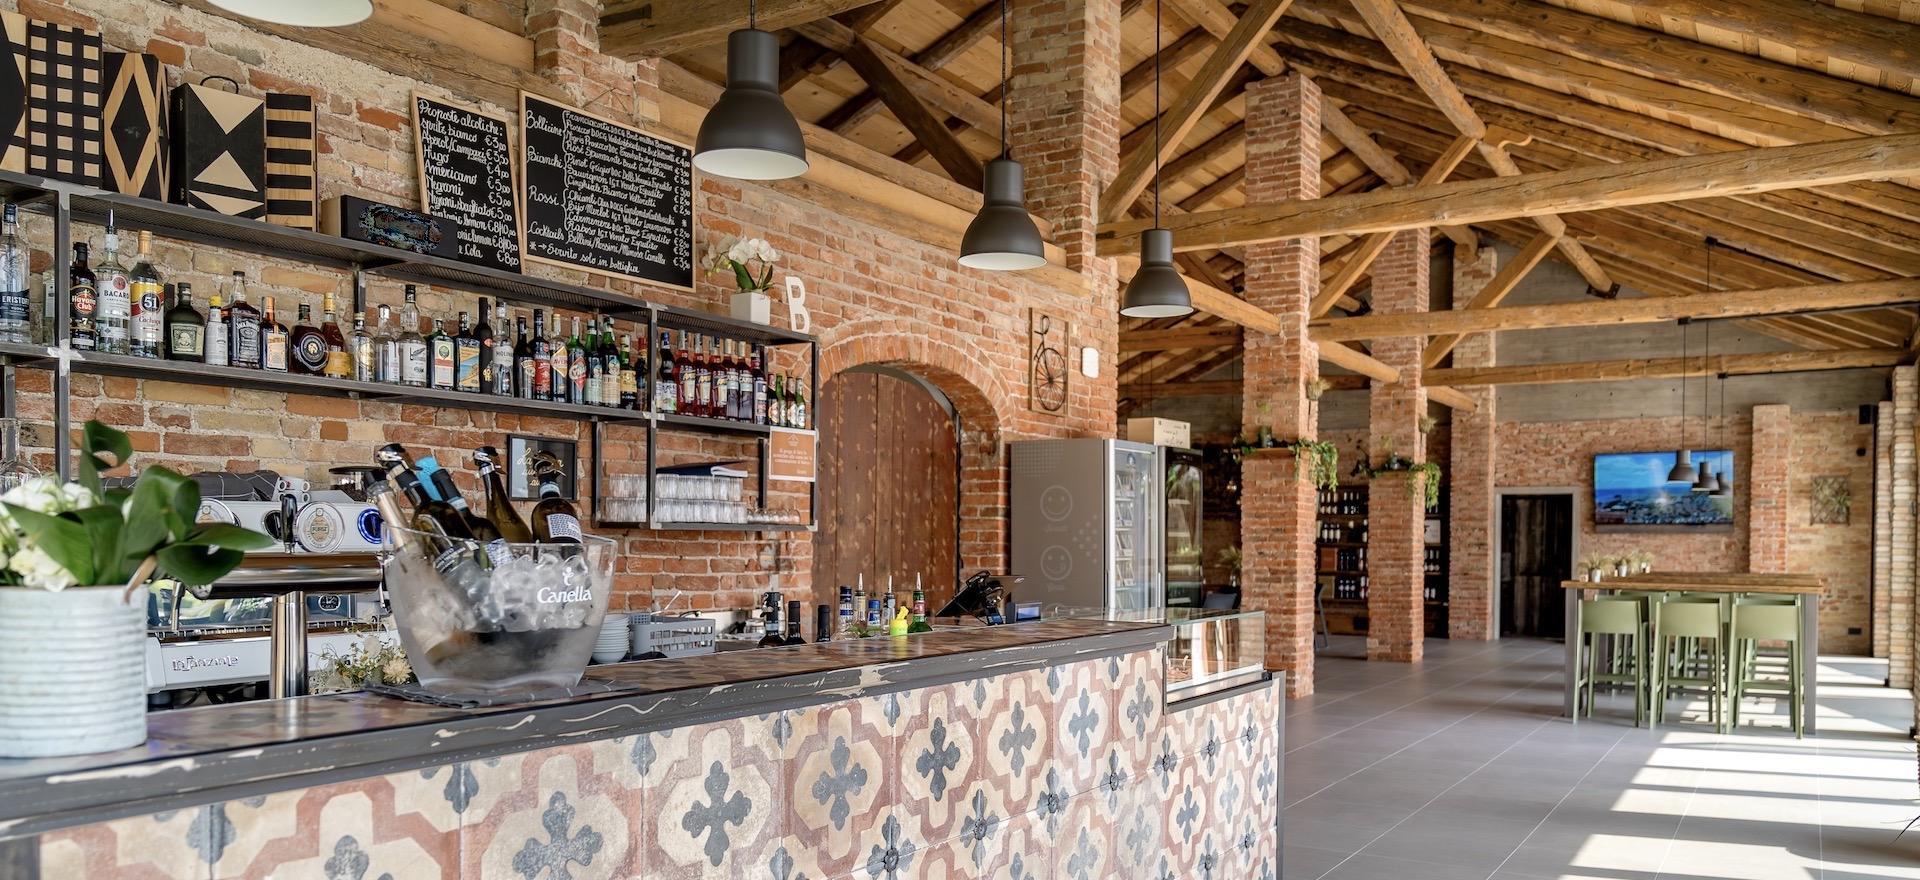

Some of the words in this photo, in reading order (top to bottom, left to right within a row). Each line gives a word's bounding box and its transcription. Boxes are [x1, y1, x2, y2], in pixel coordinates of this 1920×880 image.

[418, 99, 460, 124] Proposte
[460, 113, 503, 137] alcoliche:
[526, 110, 562, 136] Bollicine
[420, 118, 446, 135] spritz
[447, 124, 477, 142] bianco
[565, 119, 591, 135] Prosecco
[591, 128, 608, 142] DOCG
[585, 135, 609, 151] Prosecco
[423, 144, 449, 166] Hugo
[526, 146, 563, 169] Bianchi
[567, 153, 589, 168] Pinot
[585, 146, 622, 165] Spumante
[424, 159, 478, 186] Americano
[567, 164, 608, 185] Sauvignon
[425, 174, 464, 196] Negroni
[528, 185, 559, 206] Rossi
[567, 190, 598, 205] Chianti
[585, 203, 610, 218] Merlot
[528, 220, 564, 241] Cocktails
[567, 220, 596, 236] Raboso
[464, 243, 484, 259] Cola
[547, 243, 578, 259] Servito
[580, 252, 597, 264] solo
[597, 256, 608, 267] in
[609, 257, 640, 274] bottiglia
[104, 289, 130, 299] BACARD
[143, 296, 158, 309] 51
[77, 302, 92, 311] Club
[785, 276, 810, 334] B
[537, 586, 593, 604] Canella
